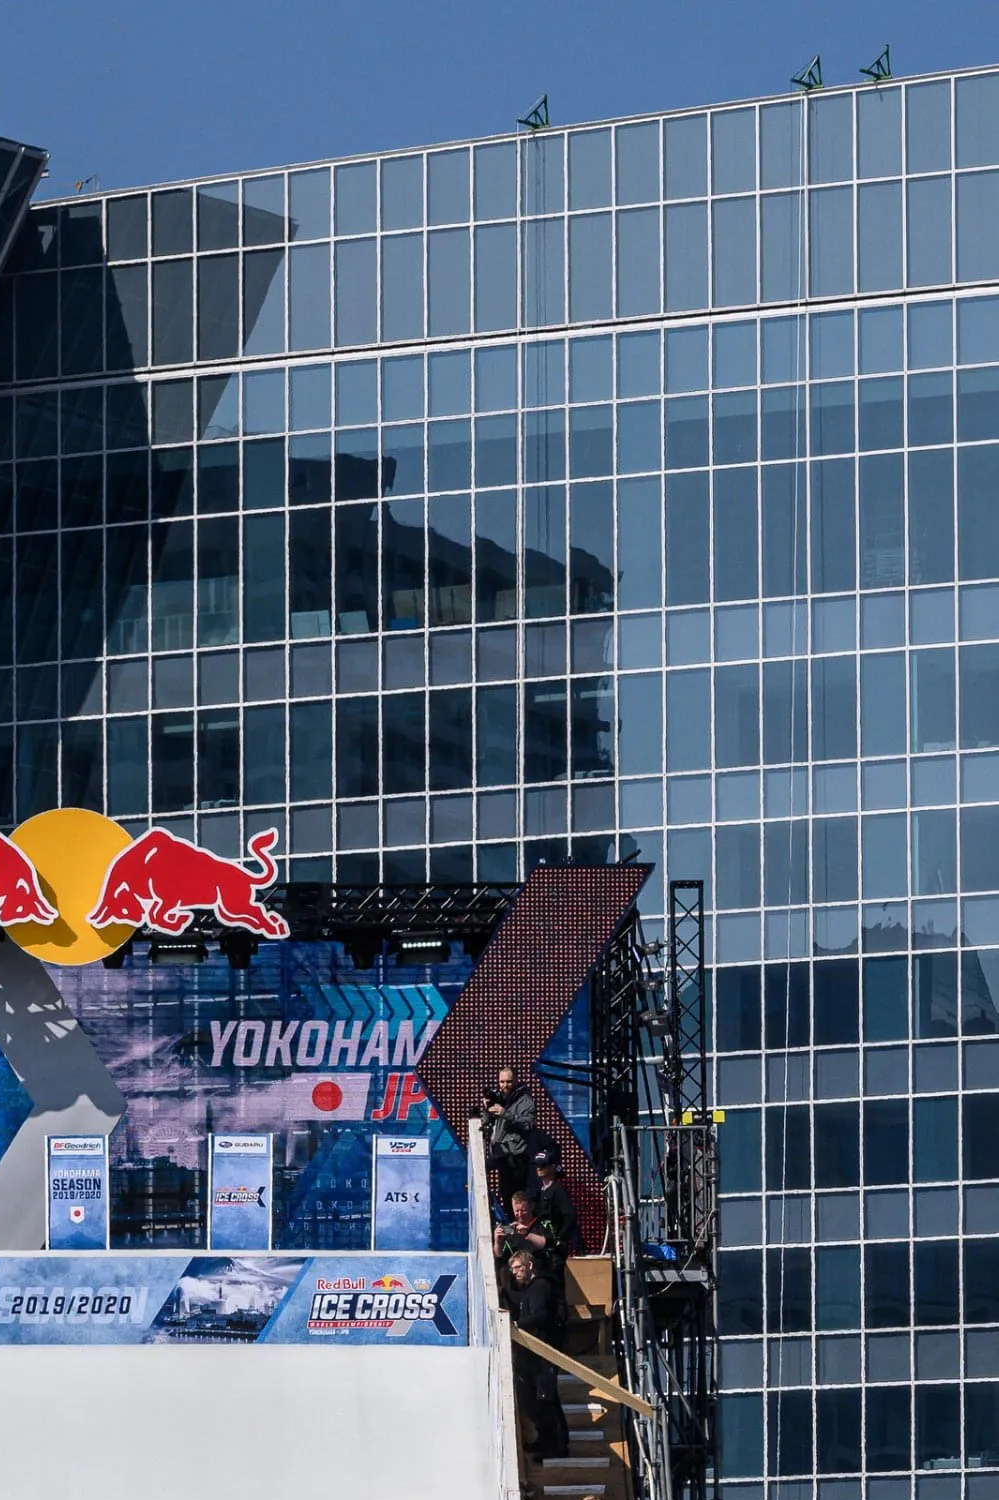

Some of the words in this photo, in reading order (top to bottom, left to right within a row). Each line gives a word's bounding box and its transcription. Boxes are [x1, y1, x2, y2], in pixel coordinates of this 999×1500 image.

[210, 1020, 442, 1067] YOKOHAM
[371, 1072, 440, 1121] JP
[52, 1178, 101, 1190] SEASON
[52, 1191, 101, 1199] 2019/2020
[215, 1192, 230, 1202] ICE
[230, 1192, 259, 1202] CROSS
[317, 1278, 341, 1290] Red
[343, 1278, 365, 1290] Bull
[10, 1296, 132, 1315] 2019/2020
[311, 1294, 352, 1320] ICE
[354, 1294, 438, 1320] CROSS
